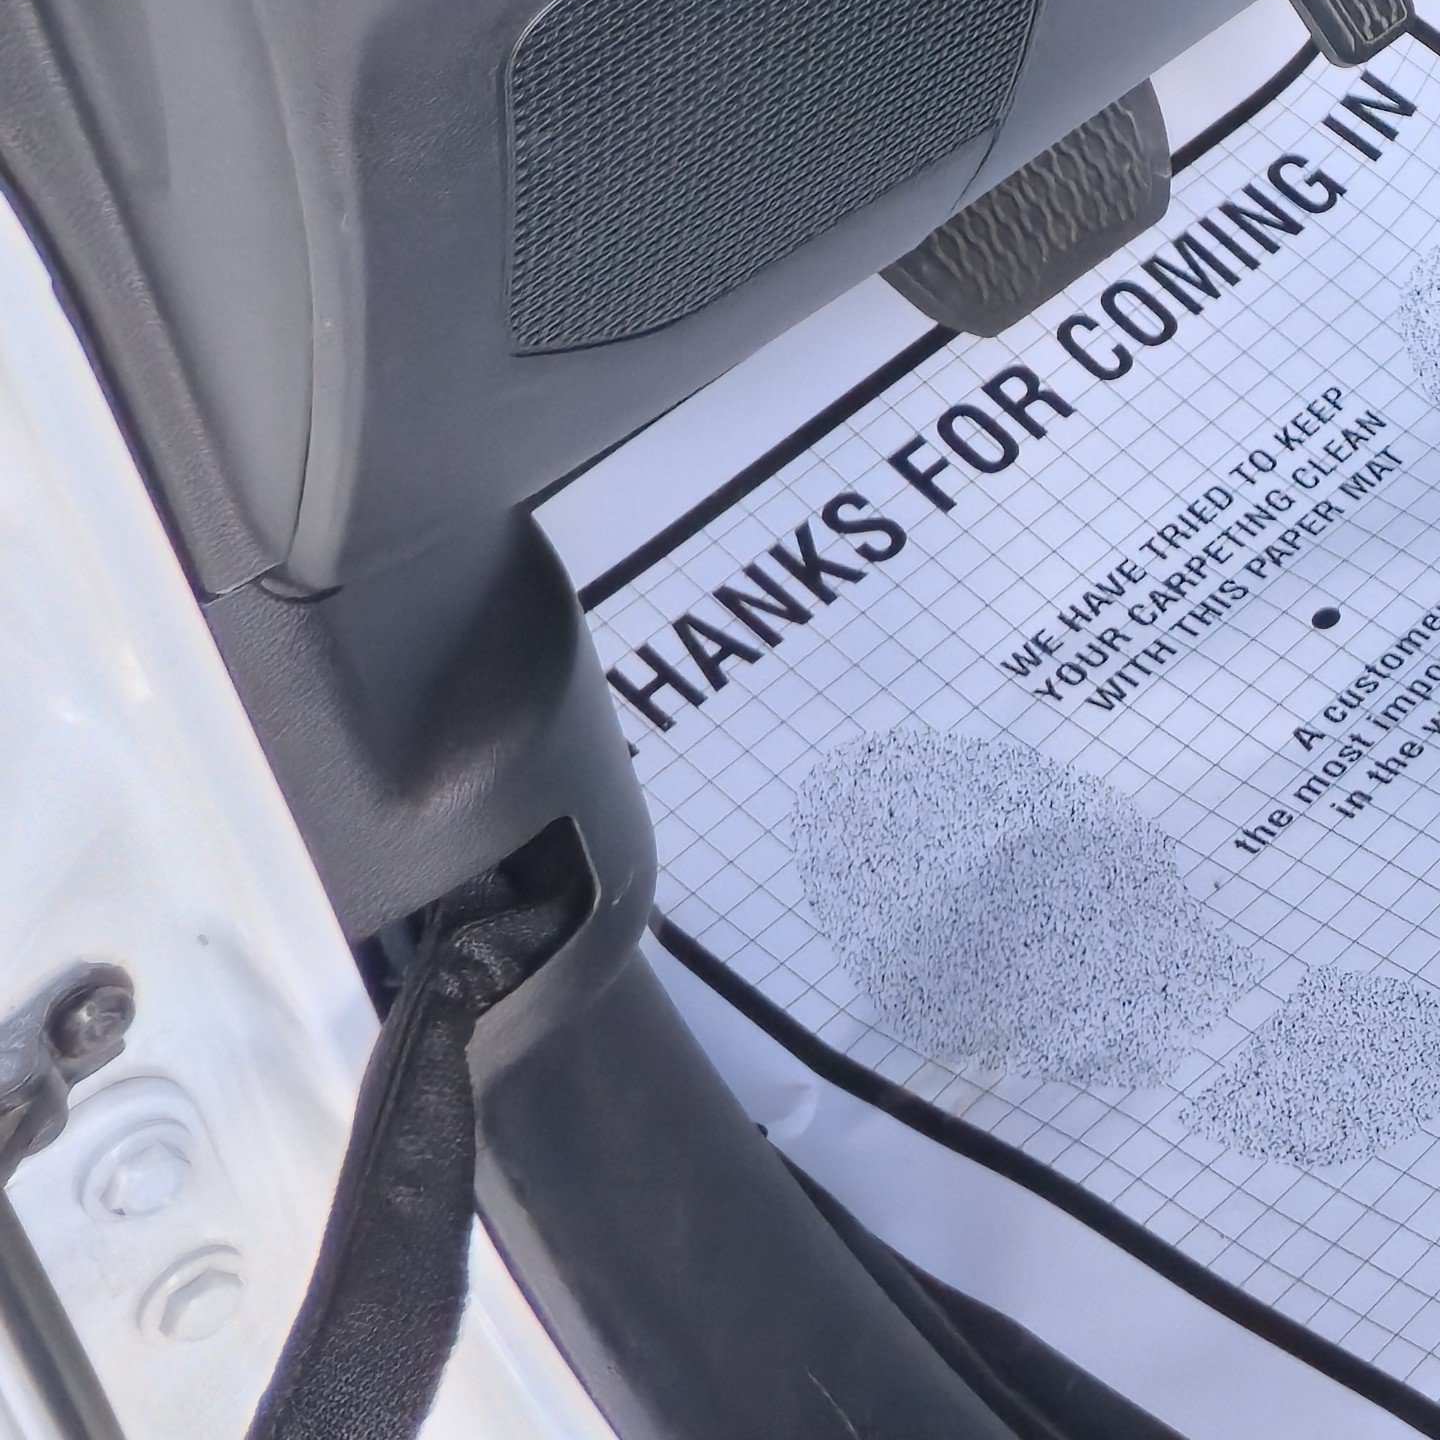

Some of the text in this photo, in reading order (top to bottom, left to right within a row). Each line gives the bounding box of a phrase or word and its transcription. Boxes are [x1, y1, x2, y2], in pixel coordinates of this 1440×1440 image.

[608, 69, 1418, 758] HANKS FOR COMING IN
[1000, 386, 1346, 678] WE HAVE TRIED TO KEEP
[1034, 408, 1389, 702] YOUR CARPETING CLEAN
[1085, 444, 1405, 714] WITH THIS PAPER MAT
[1234, 807, 1295, 855] the
[1293, 731, 1376, 804] most
[1292, 724, 1327, 752] A
[1330, 788, 1374, 820] in
[1366, 738, 1426, 785] the
